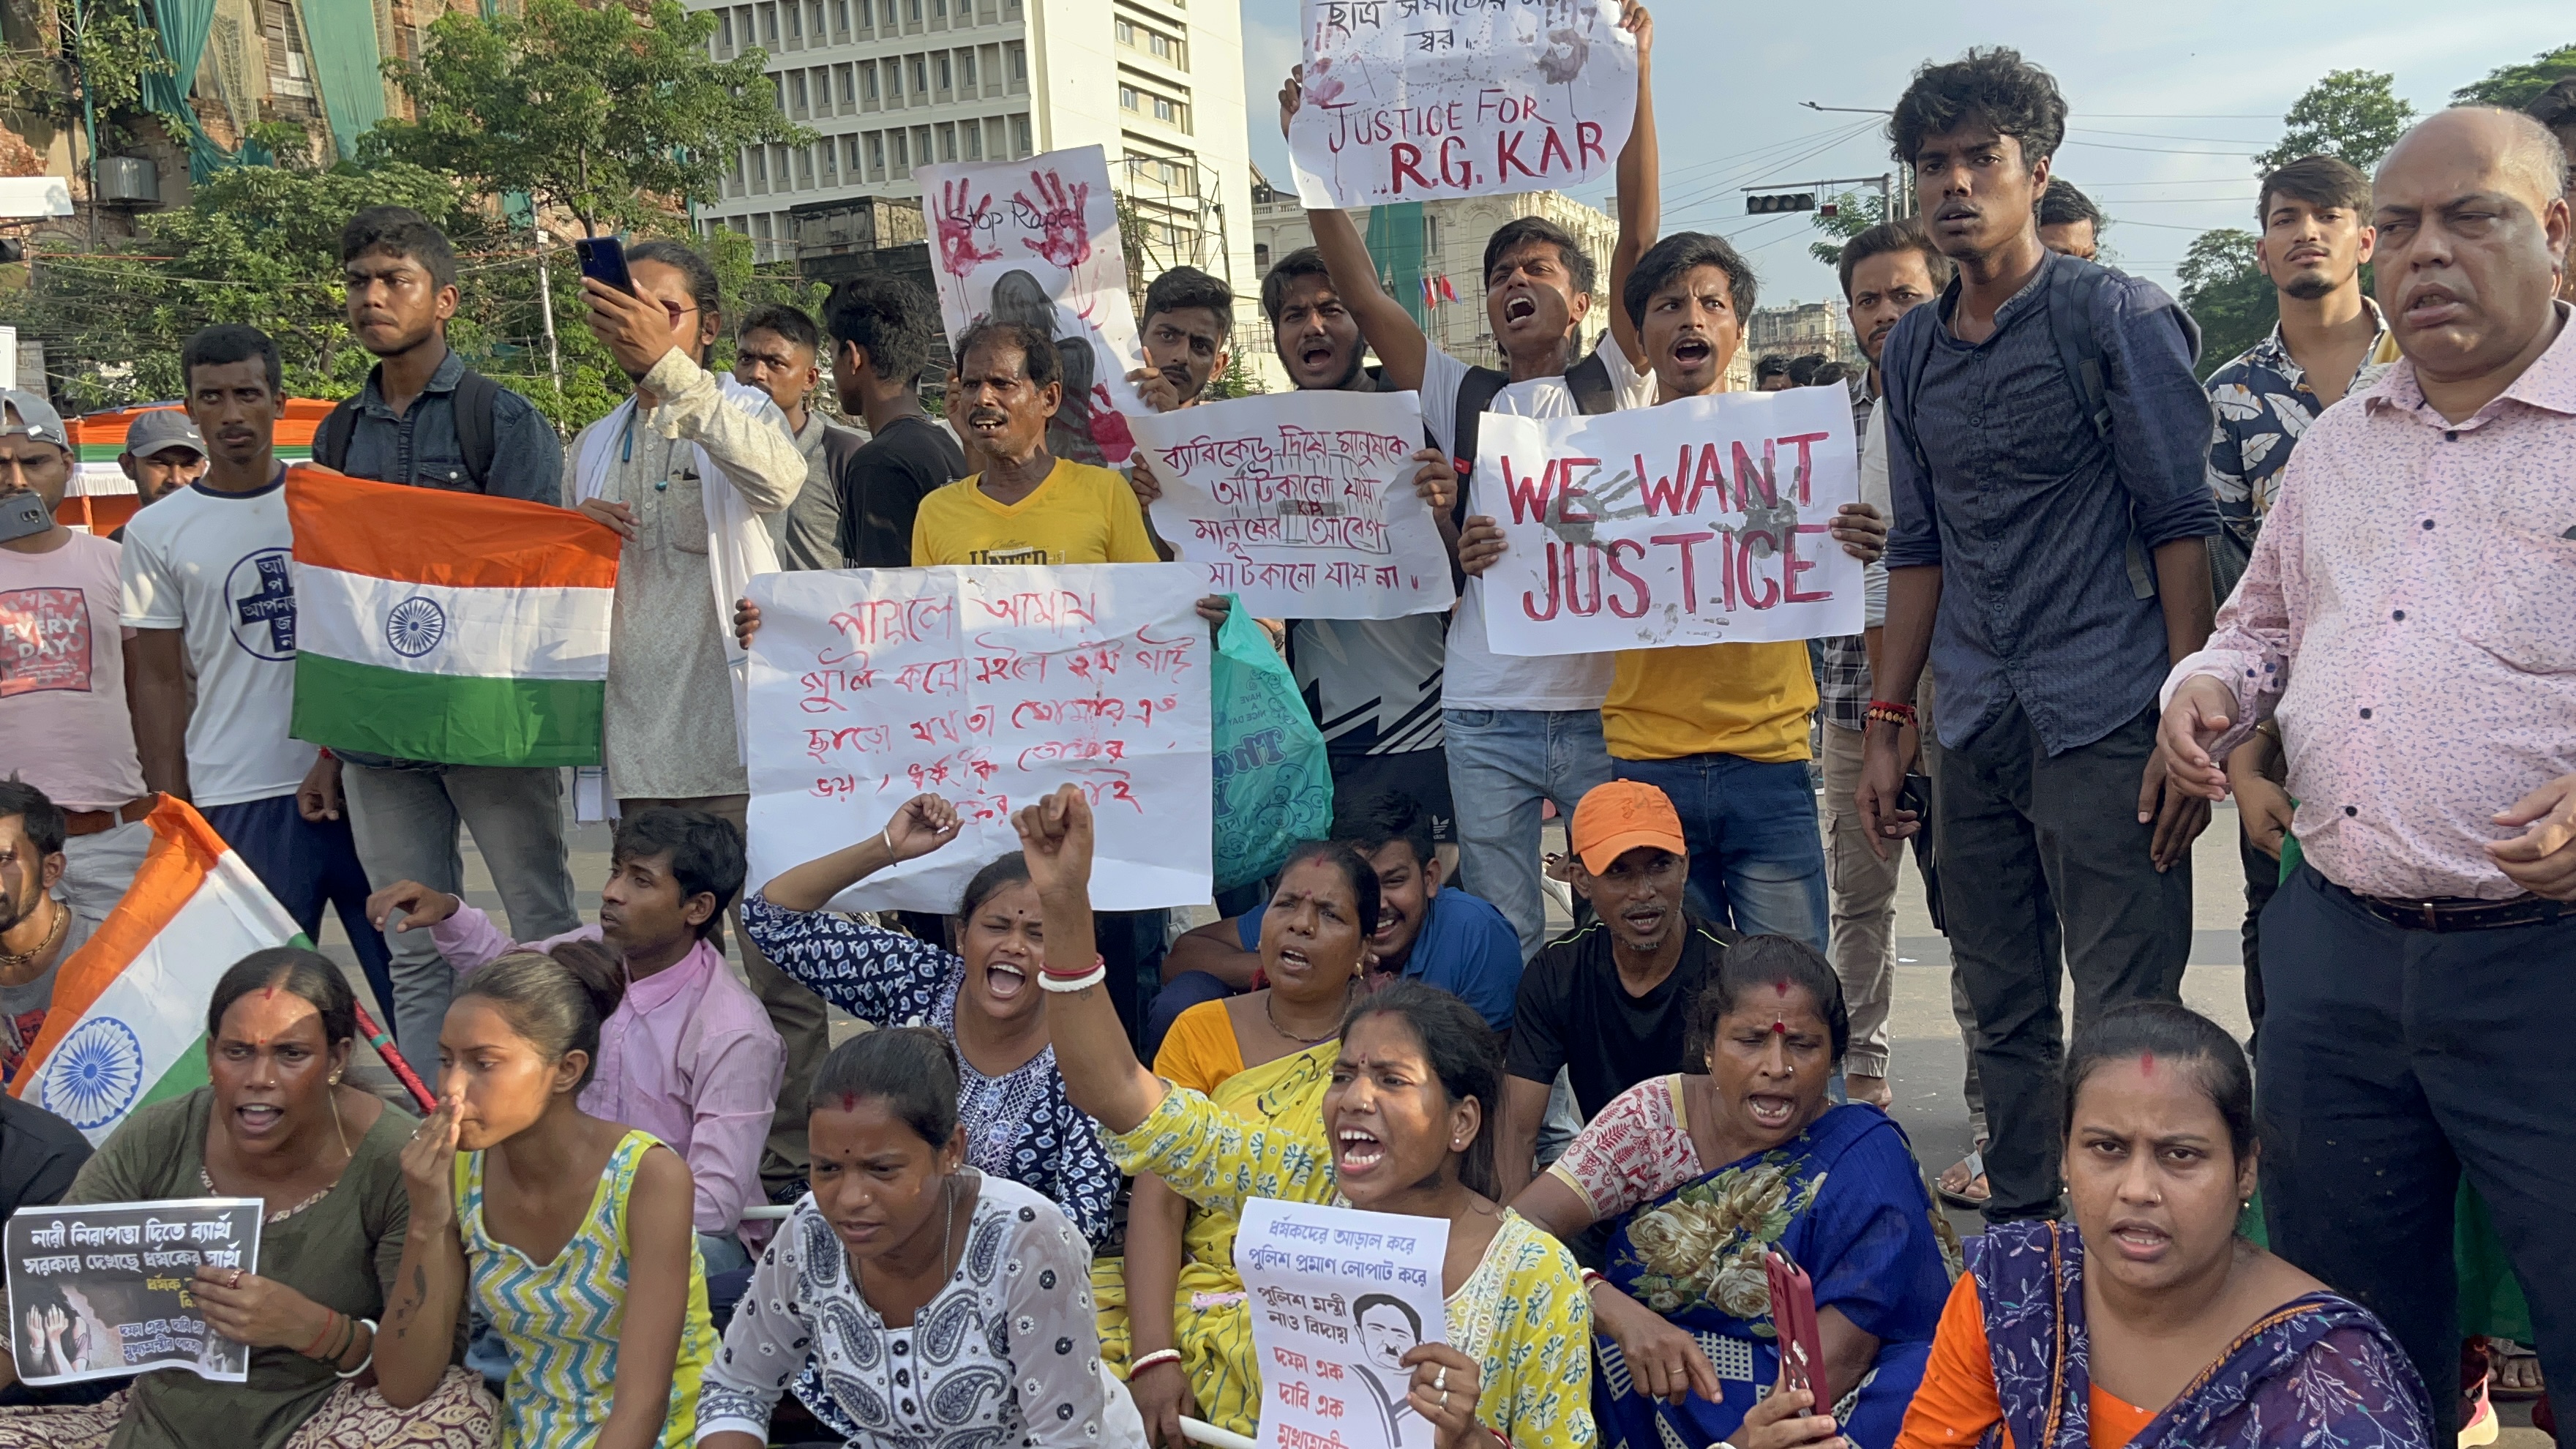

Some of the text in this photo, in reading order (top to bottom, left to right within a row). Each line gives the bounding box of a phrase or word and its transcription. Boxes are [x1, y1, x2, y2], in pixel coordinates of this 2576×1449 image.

[1321, 88, 1557, 154] JUSTICE FOR
[949, 203, 1004, 242] Stop
[1154, 424, 1409, 477] ব্যারিকেড দিয়ে মানুষকে
[1211, 460, 1336, 506] আটকানো
[1500, 431, 1830, 525] WE WANT
[1188, 517, 1390, 554] মানুষের আবেগ
[1324, 561, 1371, 592] যায়
[1374, 565, 1399, 591] না
[1523, 524, 1834, 622] JUSTICE
[3, 618, 80, 641] EVERY
[18, 637, 70, 659] DAY
[31, 1220, 66, 1249] নারী
[70, 1221, 141, 1248] নিরাপত্তা
[145, 1217, 187, 1242] দিতে
[1268, 1214, 1416, 1255] ধর্ষকদের আড়াল করে
[23, 1254, 81, 1276] সরকার
[86, 1252, 143, 1273] দেখছে
[143, 1243, 202, 1268] ধর্ষকের
[1248, 1243, 1427, 1287] পুলিশ প্রমাণ লোপাট করে
[1257, 1285, 1347, 1317] পুলিশ মন্ত্রী
[1305, 1317, 1349, 1344] বিদায়
[1273, 1346, 1344, 1382] দফা এক
[1278, 1381, 1344, 1420] দাবি এক
